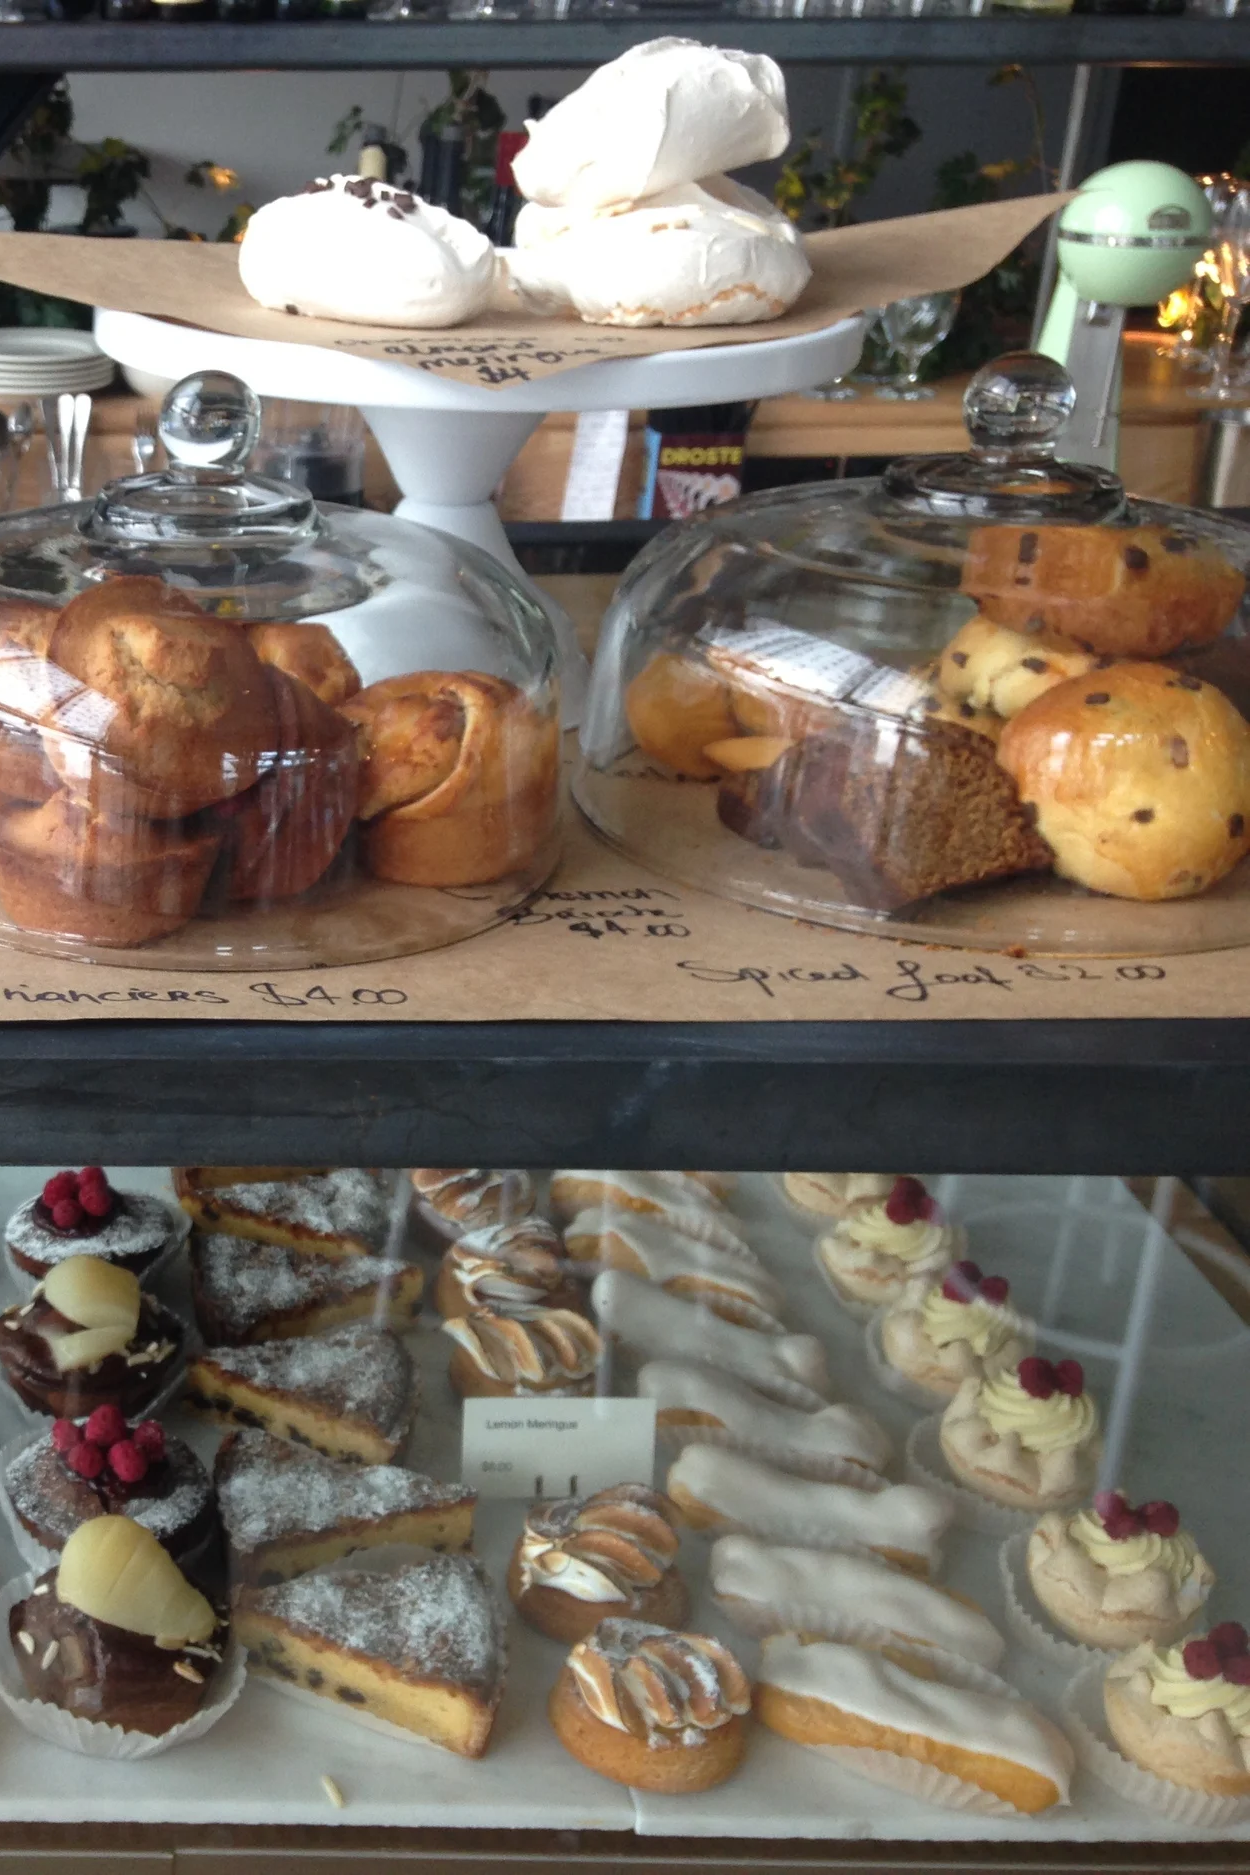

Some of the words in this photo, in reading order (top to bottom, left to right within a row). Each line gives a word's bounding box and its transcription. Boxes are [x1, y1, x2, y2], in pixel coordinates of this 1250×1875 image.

[661, 447, 743, 466] DROSTE
[676, 959, 870, 997] Spiced
[249, 981, 409, 1008] $4.00
[485, 1418, 523, 1430] Lemon
[526, 1418, 579, 1432] Meringue
